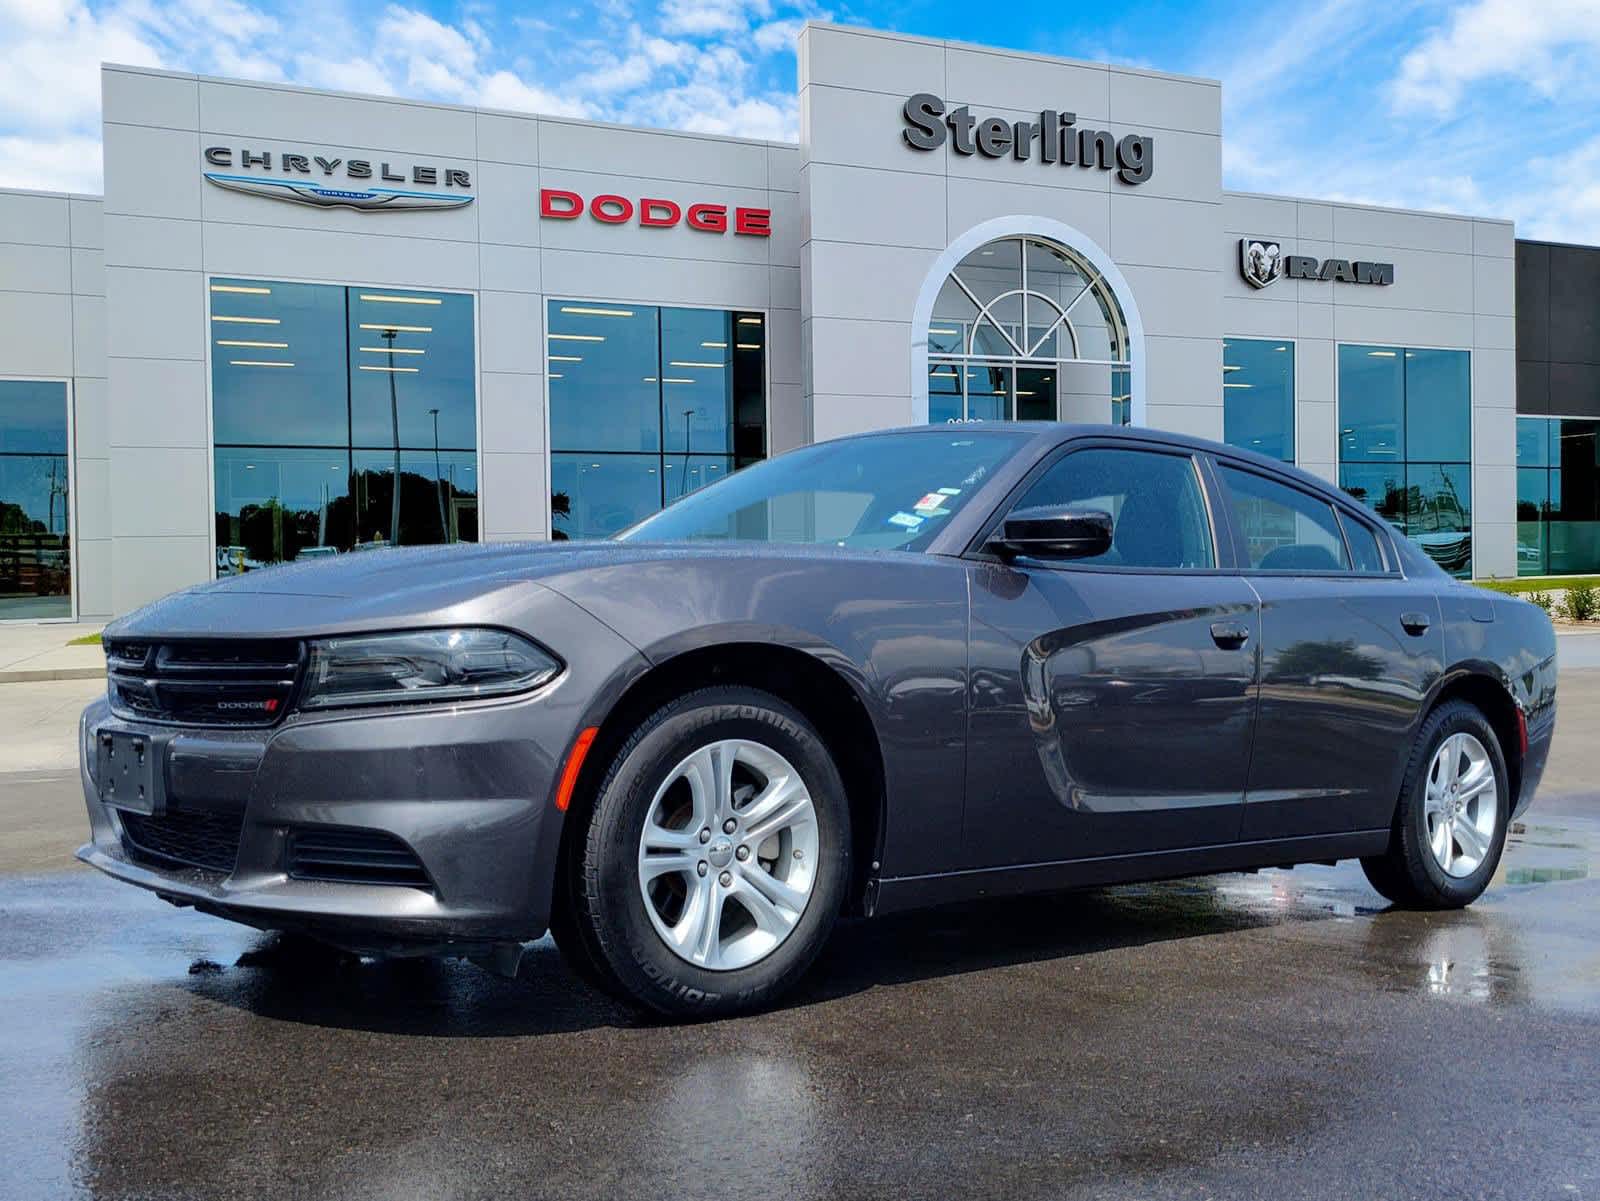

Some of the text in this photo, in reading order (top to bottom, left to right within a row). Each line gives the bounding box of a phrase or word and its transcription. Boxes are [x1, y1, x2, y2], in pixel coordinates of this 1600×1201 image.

[903, 93, 1153, 185] Sterling
[204, 146, 472, 187] CHRYSLER
[540, 188, 771, 237] DODGE
[1285, 255, 1394, 286] RAM
